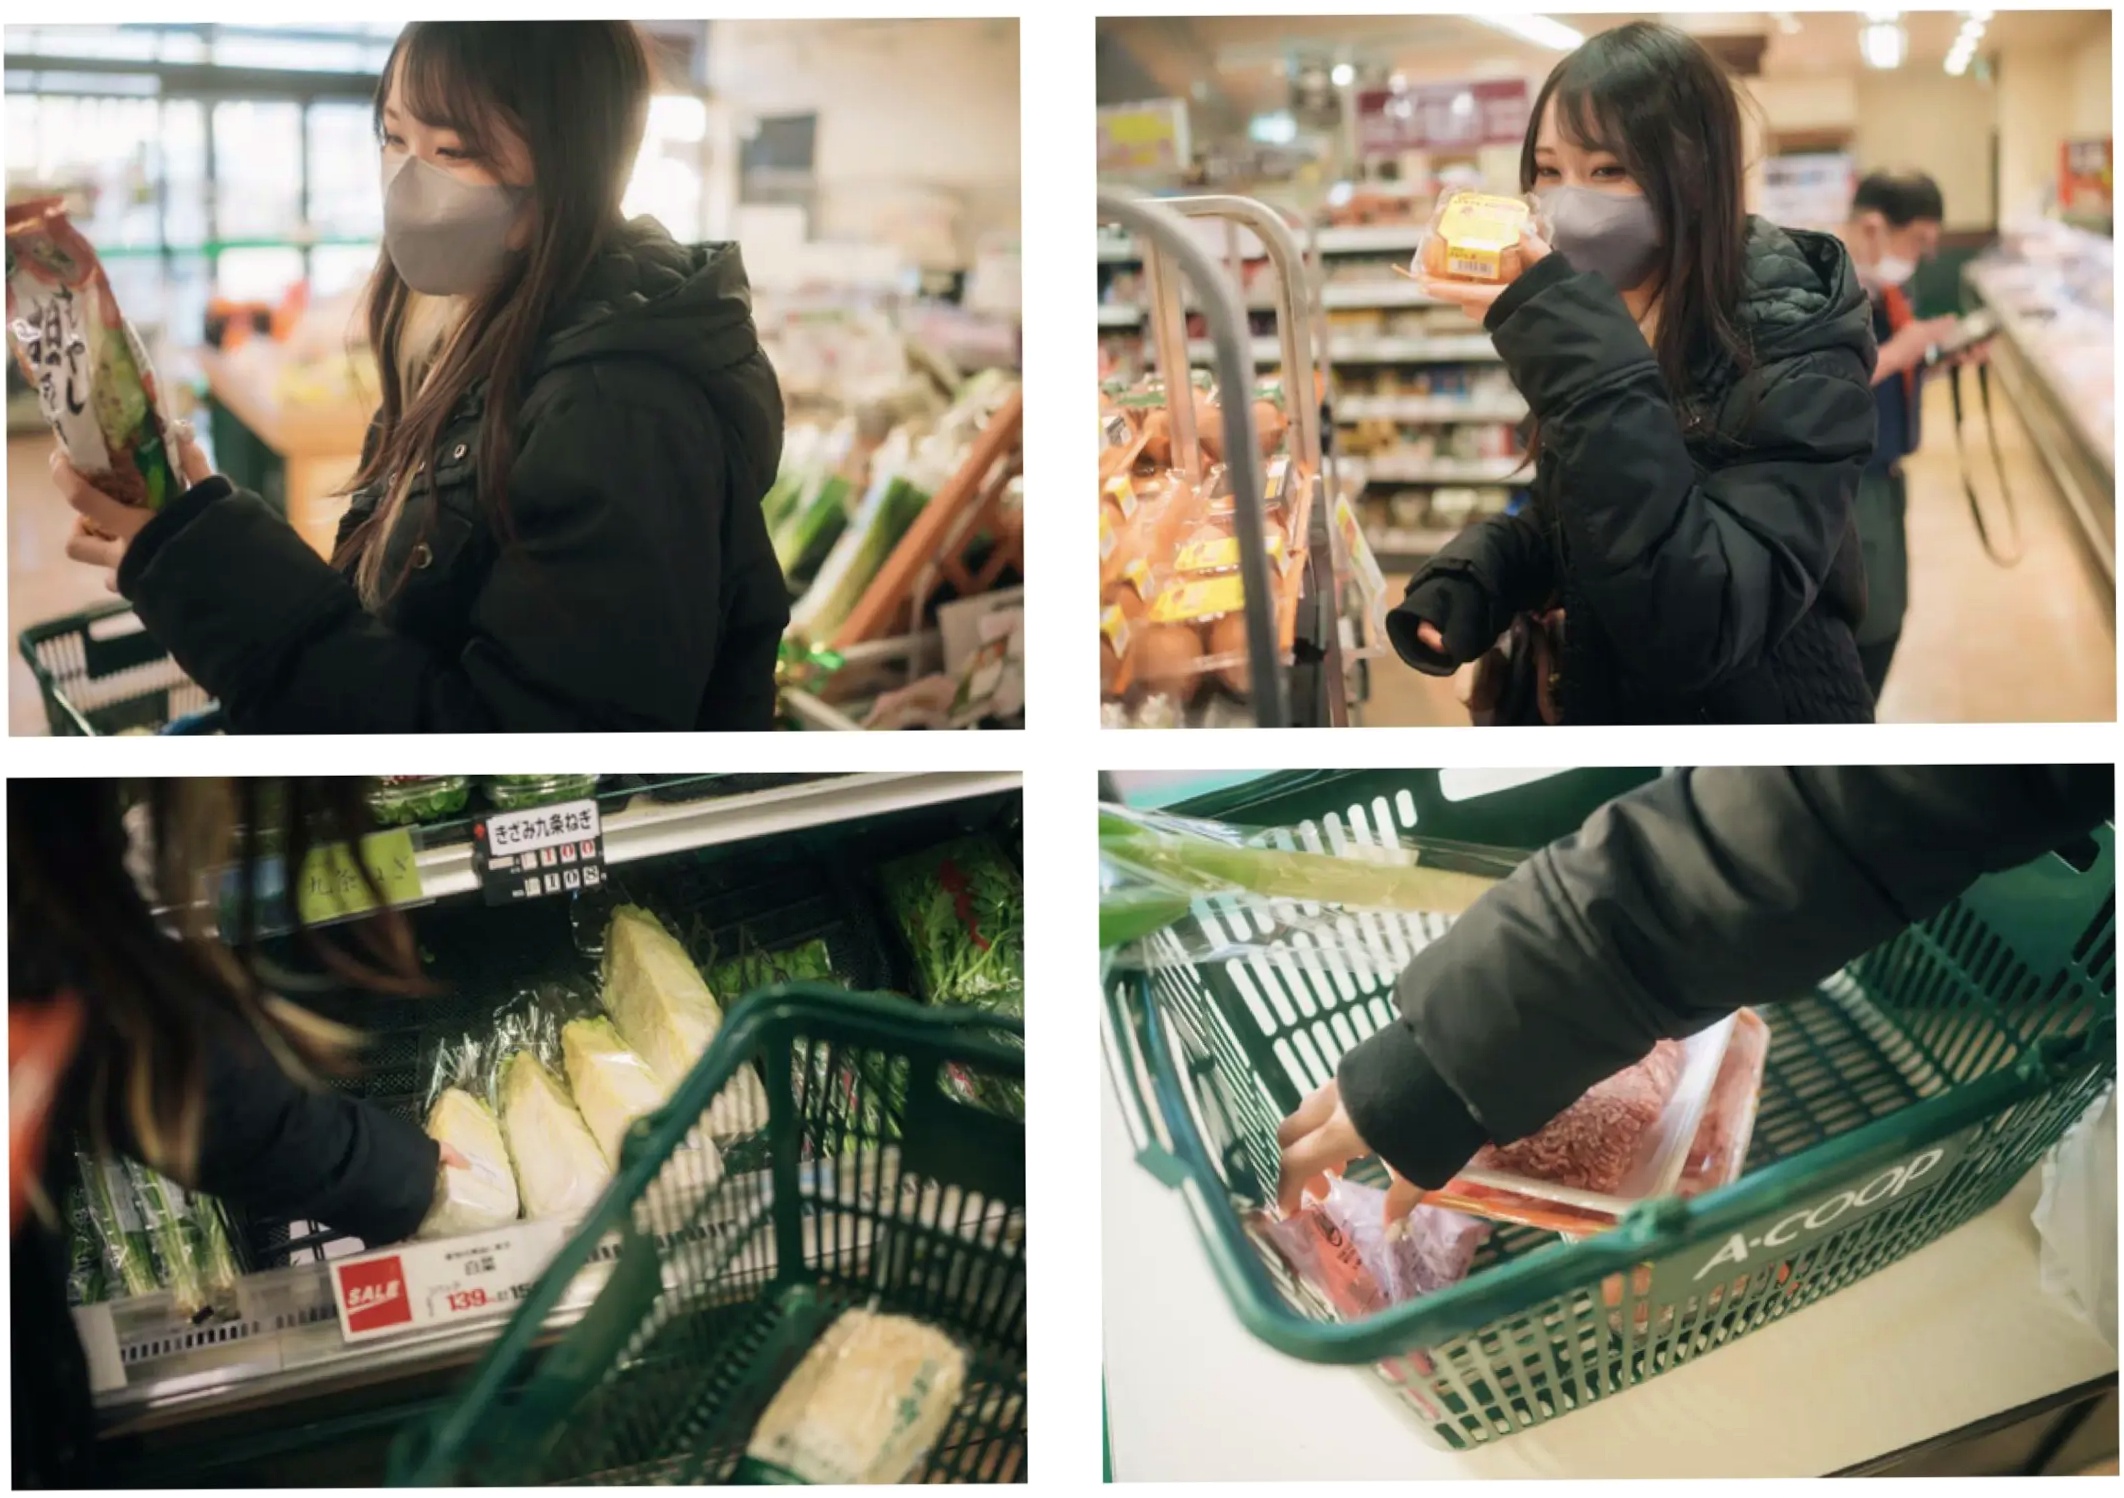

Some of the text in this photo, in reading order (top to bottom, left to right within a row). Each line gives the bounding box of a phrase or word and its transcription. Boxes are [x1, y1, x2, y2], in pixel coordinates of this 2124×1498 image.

[495, 808, 593, 846] きざみ九条ねぎ
[546, 840, 595, 863] 100
[547, 867, 599, 889] 108
[347, 1279, 400, 1306] SALE
[447, 1287, 488, 1312] 139
